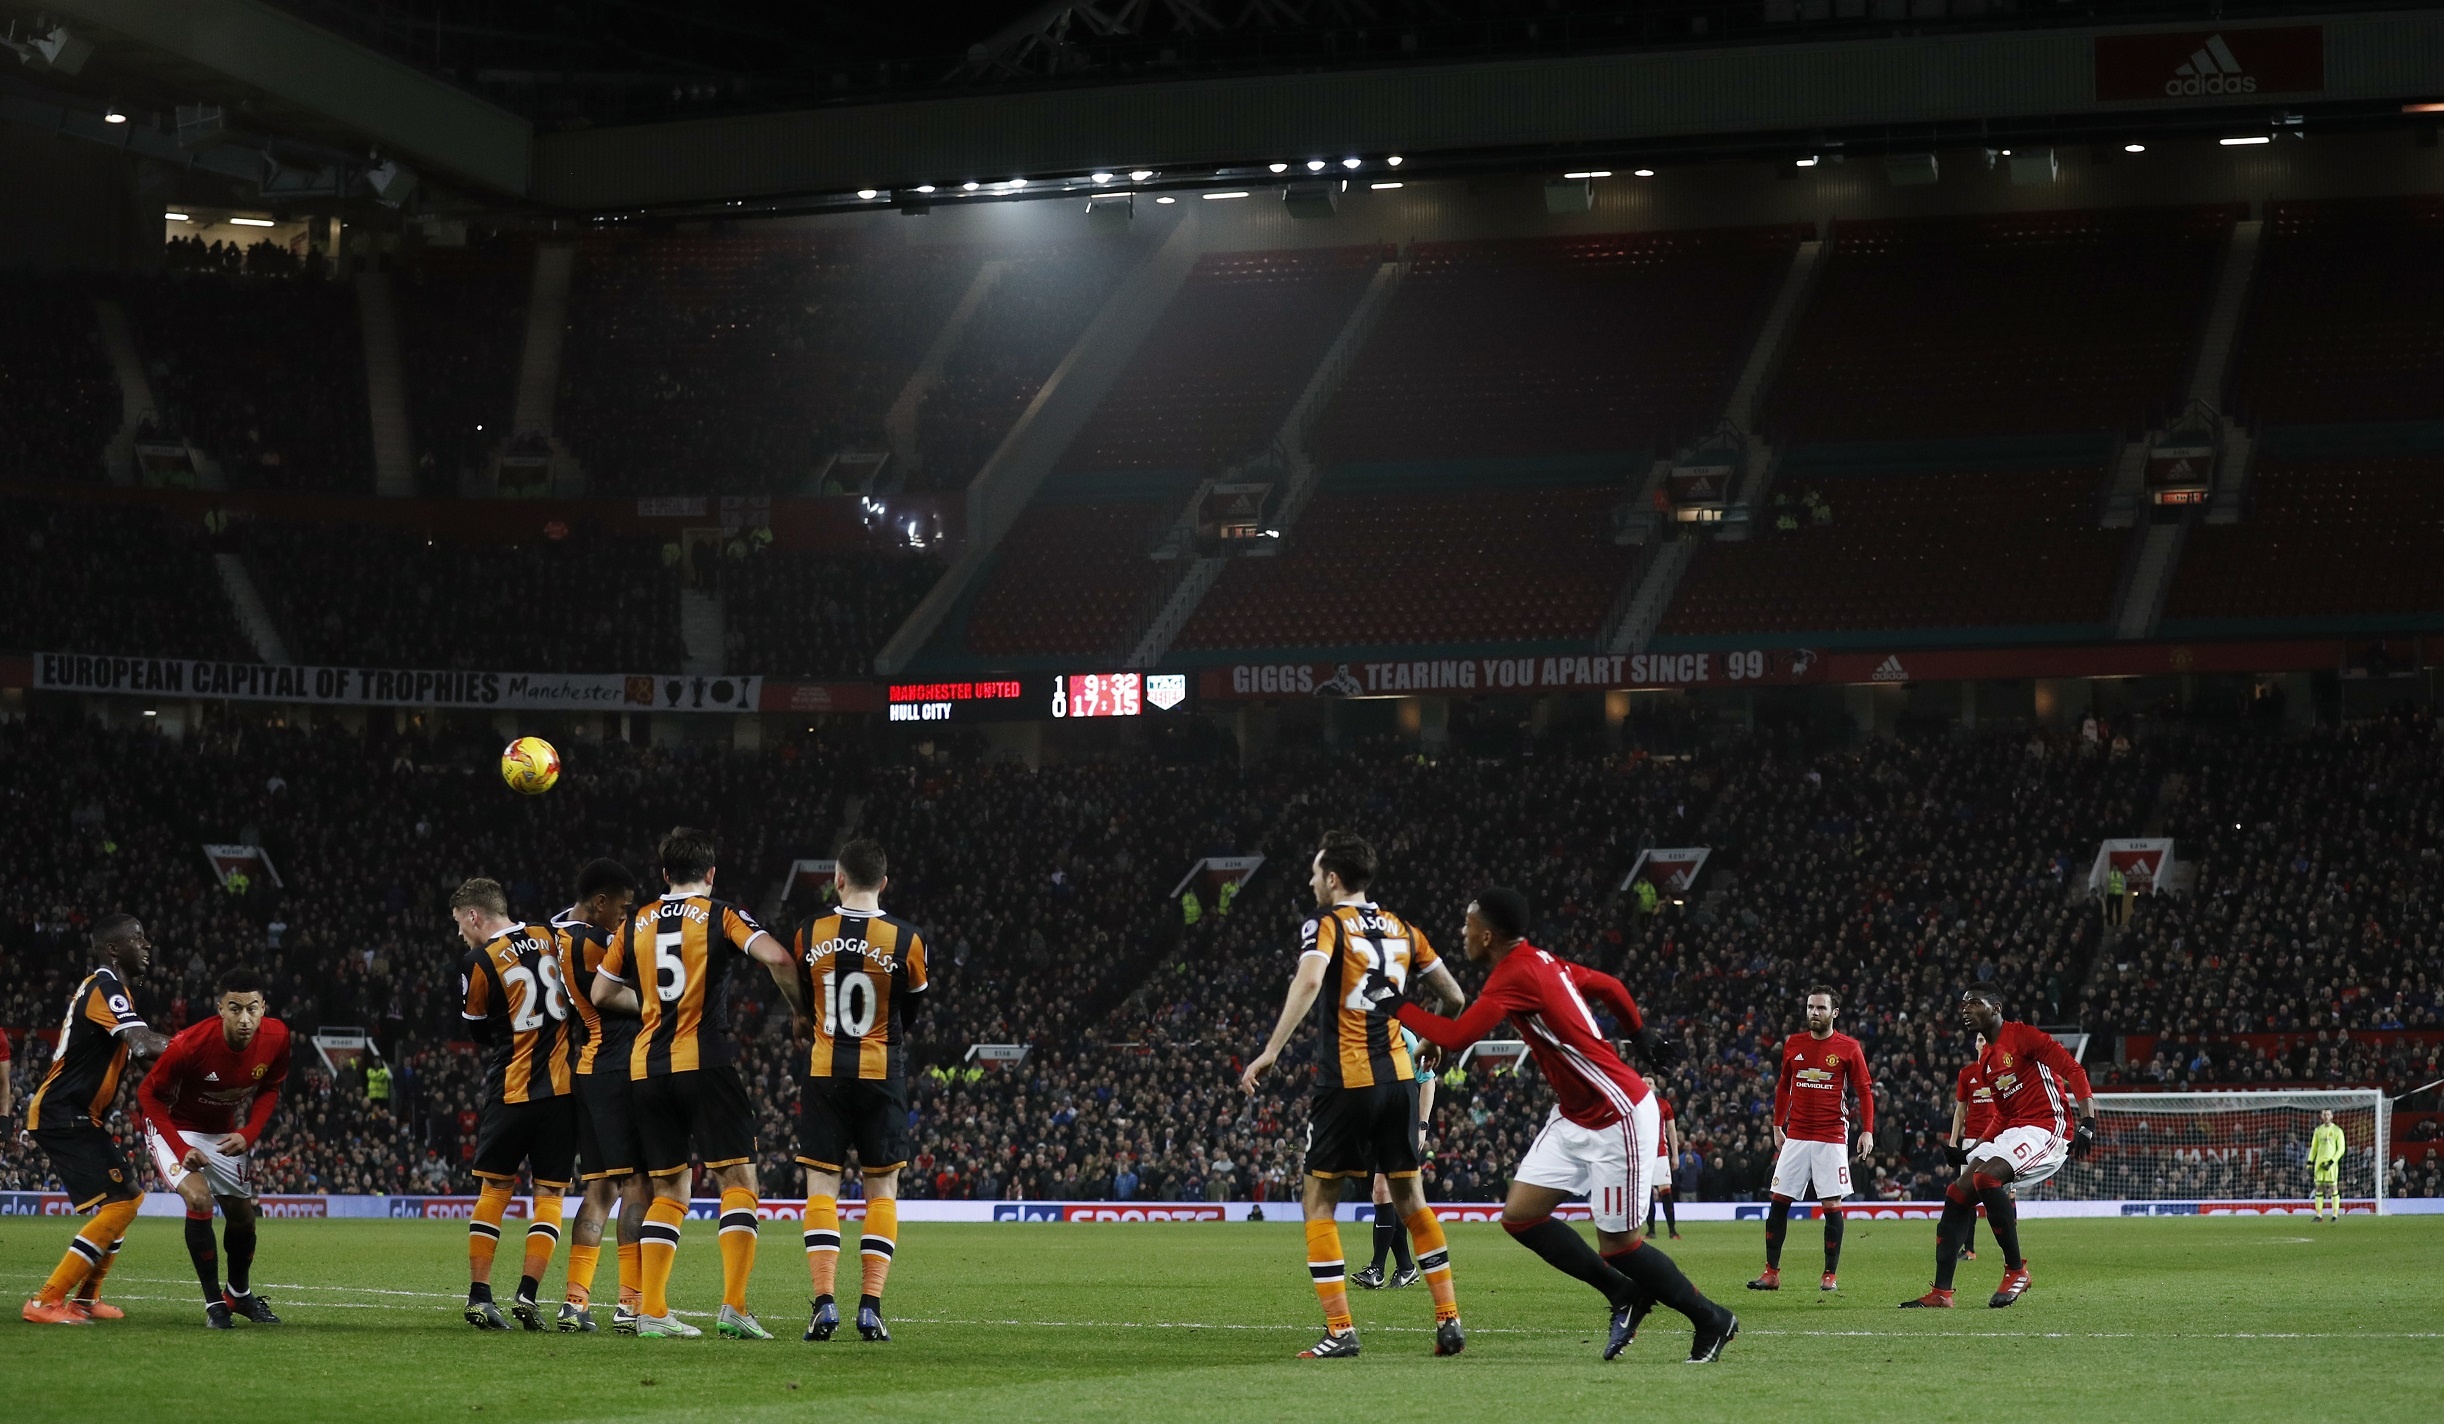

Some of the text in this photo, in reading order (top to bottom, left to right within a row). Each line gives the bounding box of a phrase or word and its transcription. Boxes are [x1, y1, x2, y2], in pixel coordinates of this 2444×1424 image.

[2165, 72, 2257, 96] adidas
[43, 655, 183, 691] EUROPEAN
[192, 663, 307, 697] CAPITAL
[316, 667, 349, 699] OF
[358, 670, 499, 704] TROPHIES
[508, 676, 622, 699] Manchester
[1233, 665, 1313, 693] GIGGS
[1365, 660, 1475, 690] TEARING
[1483, 658, 1534, 687] YOU
[1541, 656, 1625, 685] APART
[1631, 654, 1708, 683] SINCE
[1872, 671, 1908, 681] adidas
[889, 681, 1020, 701] MANCHESTER UNITED
[1053, 675, 1066, 698] 1
[1084, 673, 1138, 700] 9:32
[890, 703, 951, 721] HULL CITY
[1052, 698, 1067, 718] 0
[1073, 695, 1138, 717] 17:15
[635, 904, 710, 933] MAGUIRE
[1344, 915, 1398, 936] MASON
[499, 938, 550, 963] TYMON
[805, 937, 898, 973] SNODGRASS
[655, 930, 687, 1002] 5
[1345, 936, 1409, 1011] 25
[503, 955, 570, 1032] 28
[822, 970, 877, 1037] 10
[1796, 1081, 1834, 1090] CHEVROLET
[2012, 1142, 2033, 1160] 6
[1838, 1166, 1849, 1185] 8
[262, 1203, 326, 1217] PORTS
[427, 1204, 521, 1219] SPOS
[1604, 1186, 1622, 1215] 11
